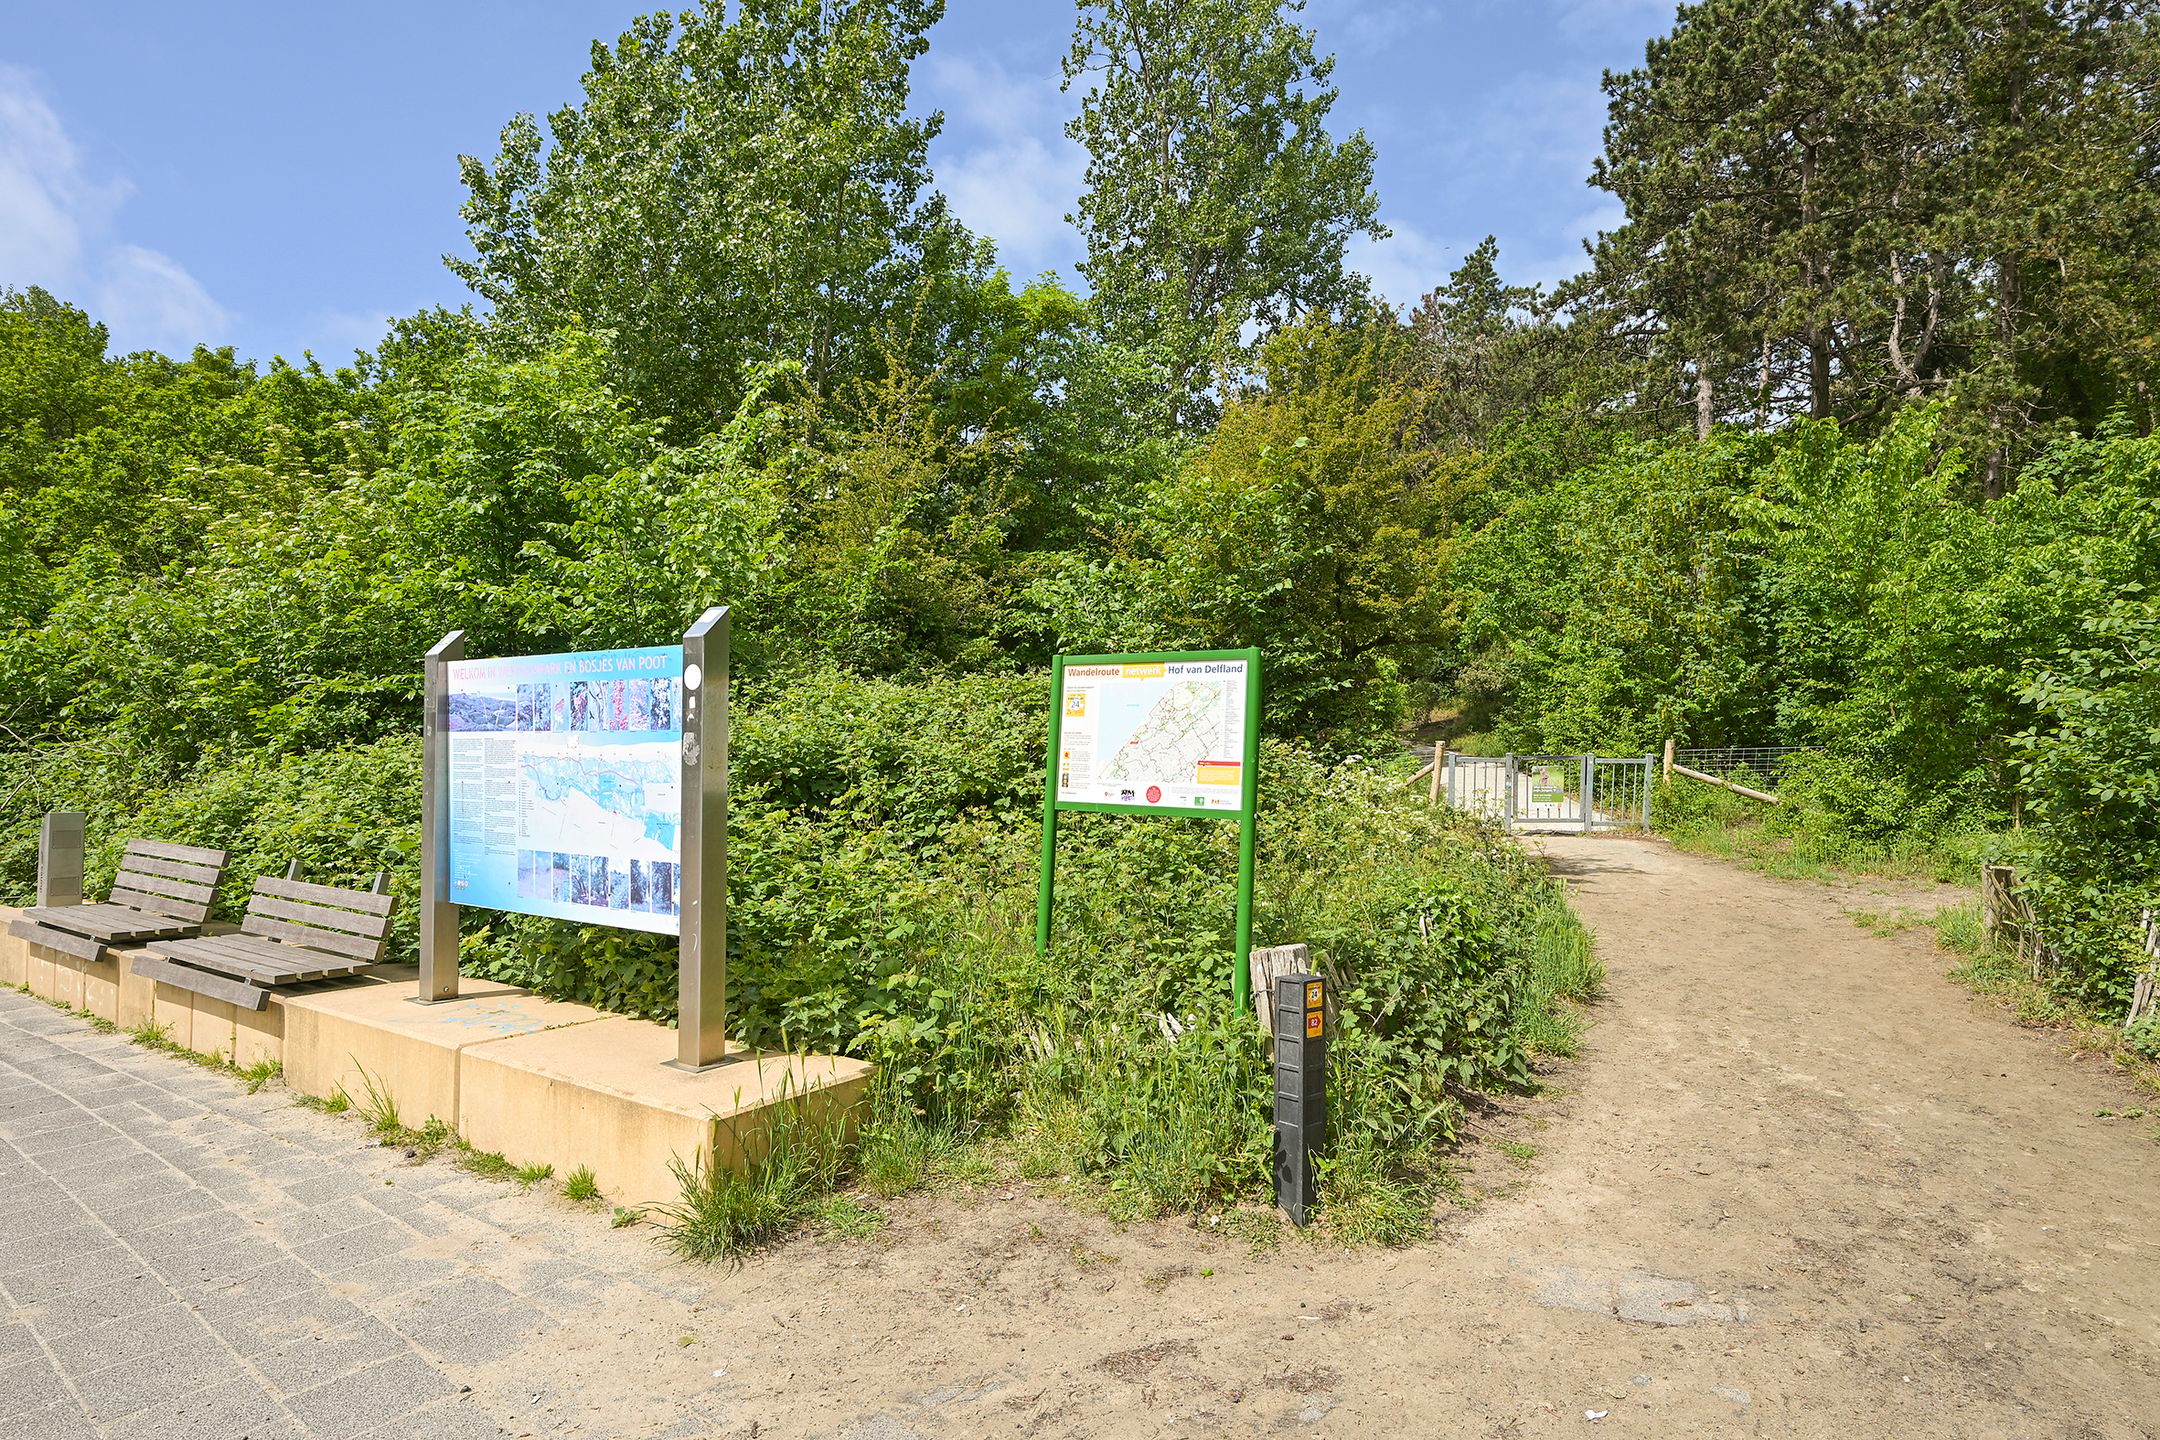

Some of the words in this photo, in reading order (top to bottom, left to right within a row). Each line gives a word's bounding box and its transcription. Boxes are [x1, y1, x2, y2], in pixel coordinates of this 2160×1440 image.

[453, 667, 486, 680] WELKOM
[487, 667, 496, 679] IN
[563, 661, 577, 673] EN
[579, 658, 613, 673] BOSJES
[615, 657, 635, 671] VAN
[638, 655, 668, 670] POOT
[1068, 667, 1120, 677] Wandelroute
[1125, 666, 1160, 675] netwerk
[1168, 665, 1184, 674] Hof
[1204, 664, 1243, 674] Delfland
[1071, 701, 1080, 709] 24
